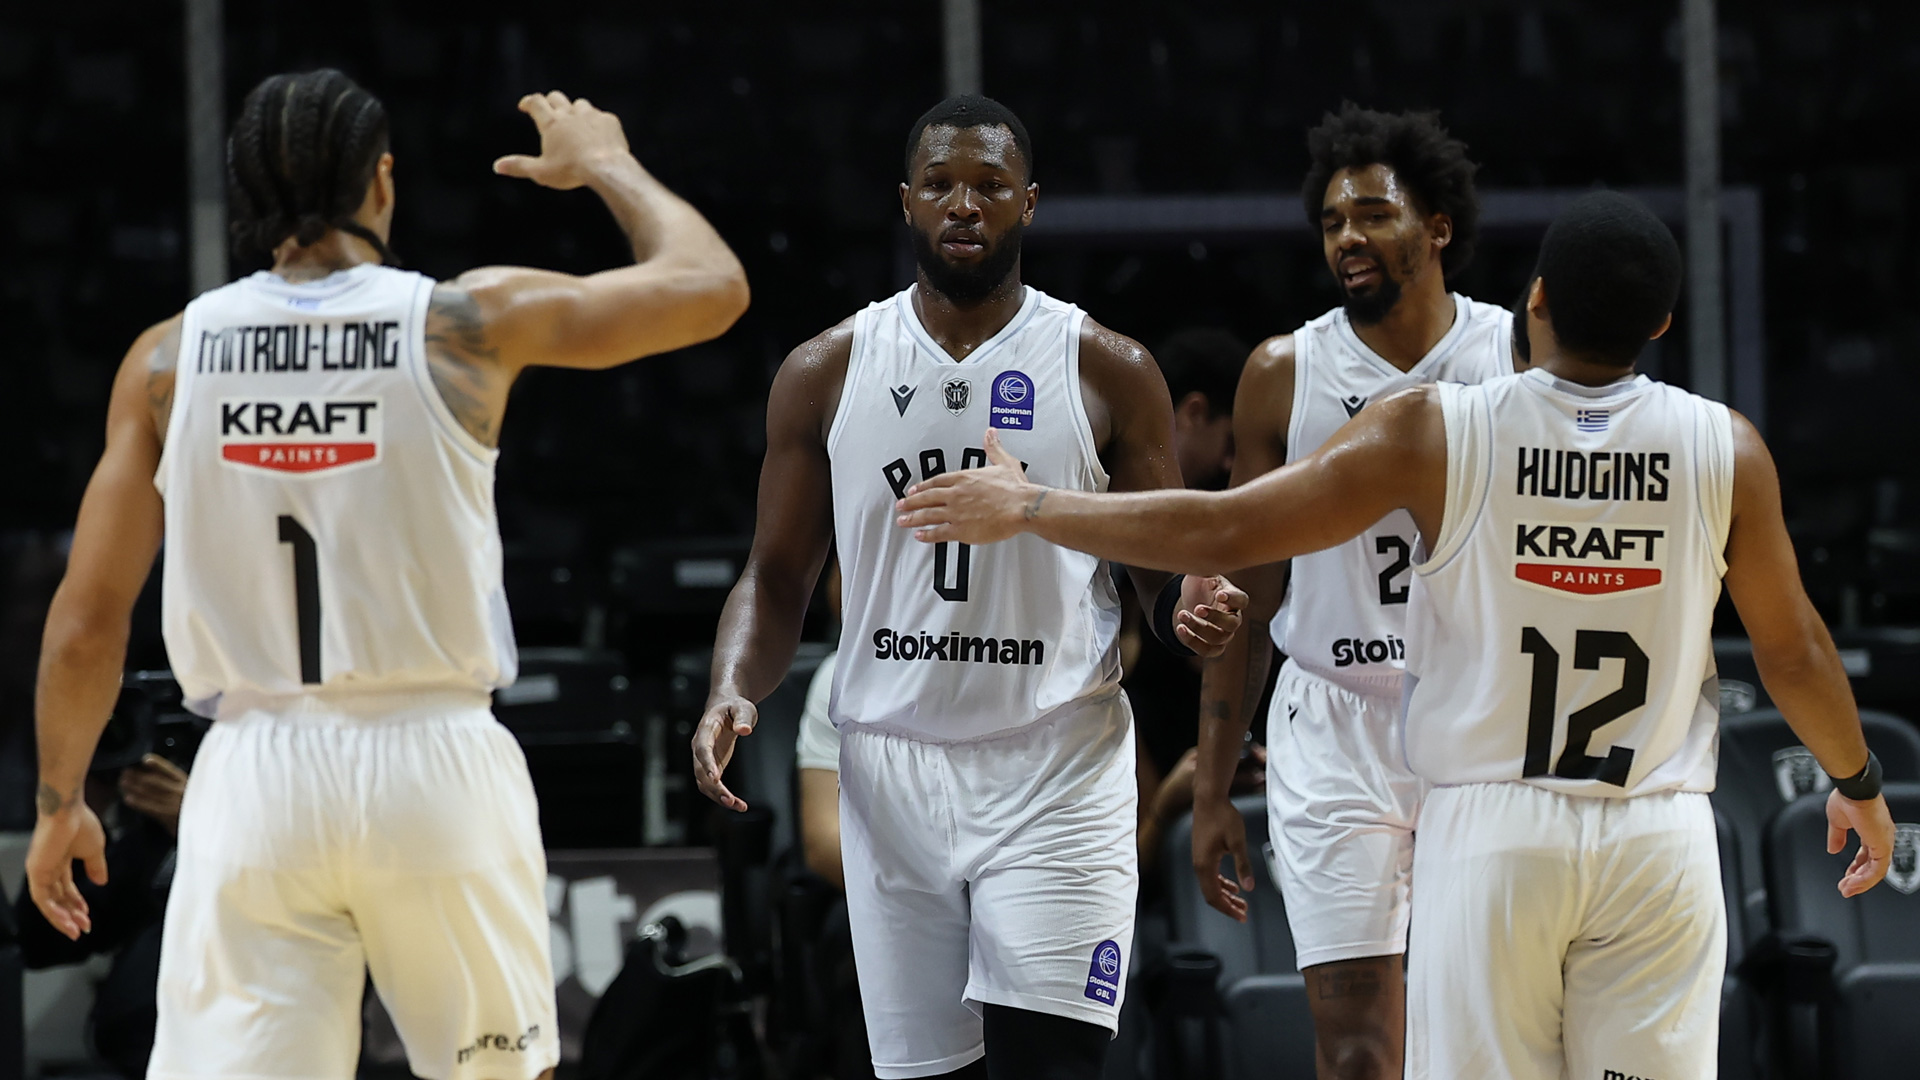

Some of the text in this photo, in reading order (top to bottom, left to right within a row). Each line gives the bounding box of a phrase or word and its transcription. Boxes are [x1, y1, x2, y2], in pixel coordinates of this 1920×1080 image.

[198, 321, 400, 374] MITROU-LONG
[221, 402, 377, 435] KRAFT
[1001, 417, 1022, 425] GBL
[259, 447, 338, 463] PAINTS
[882, 447, 1029, 500] PA
[1516, 446, 1670, 501] HUDGINS
[1516, 524, 1664, 561] KRAFT
[1376, 535, 1411, 605] 2
[1552, 571, 1625, 585] PAINTS
[277, 514, 322, 684] 1
[873, 628, 1044, 665] Stoiximan
[1521, 627, 1649, 787] 12
[1095, 988, 1111, 999] GBL
